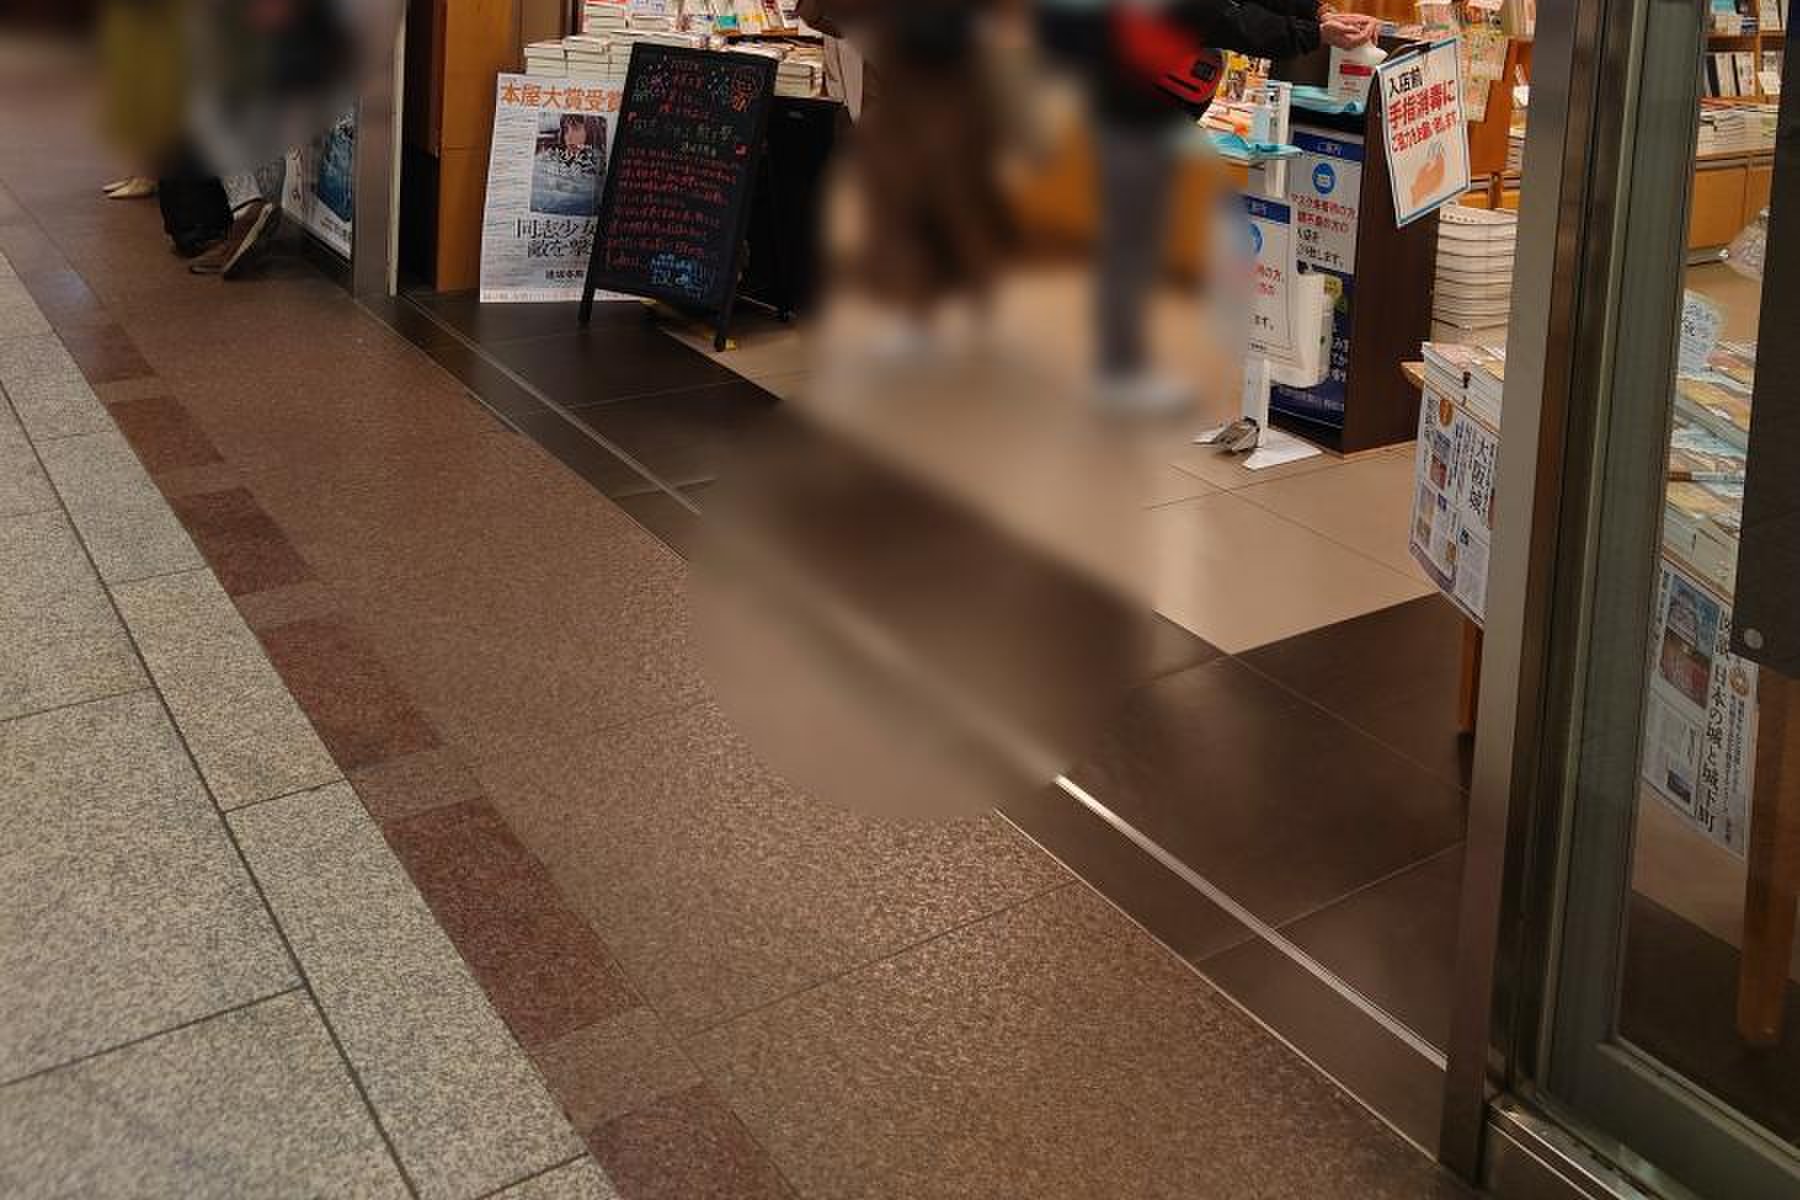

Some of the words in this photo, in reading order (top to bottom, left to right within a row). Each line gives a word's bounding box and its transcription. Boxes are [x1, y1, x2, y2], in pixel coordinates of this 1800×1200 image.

[1389, 80, 1456, 129] 手指消毒に
